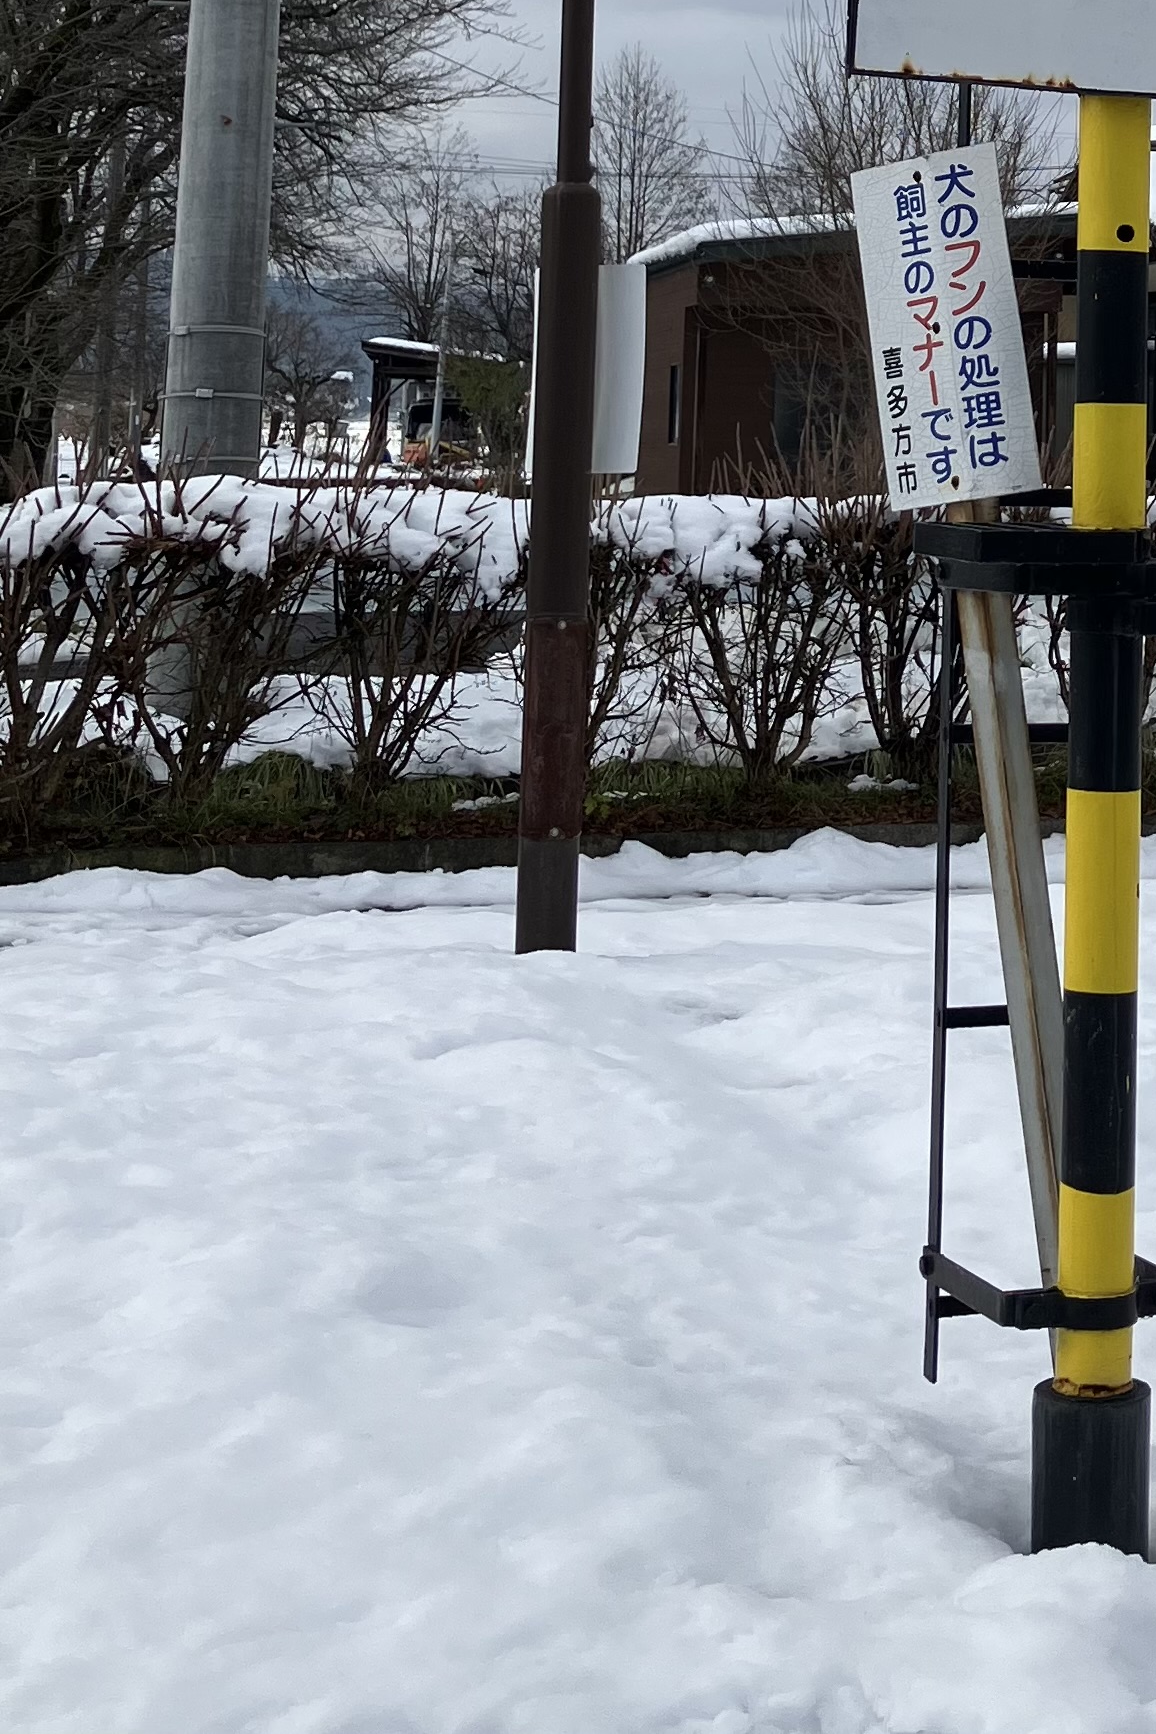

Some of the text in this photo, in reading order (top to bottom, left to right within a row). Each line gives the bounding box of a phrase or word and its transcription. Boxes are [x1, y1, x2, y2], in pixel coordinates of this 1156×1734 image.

[882, 347, 918, 494] 喜多方市
[893, 183, 957, 483] 飼主のマナーです
[934, 163, 1009, 469] 犬のフンの処理は
